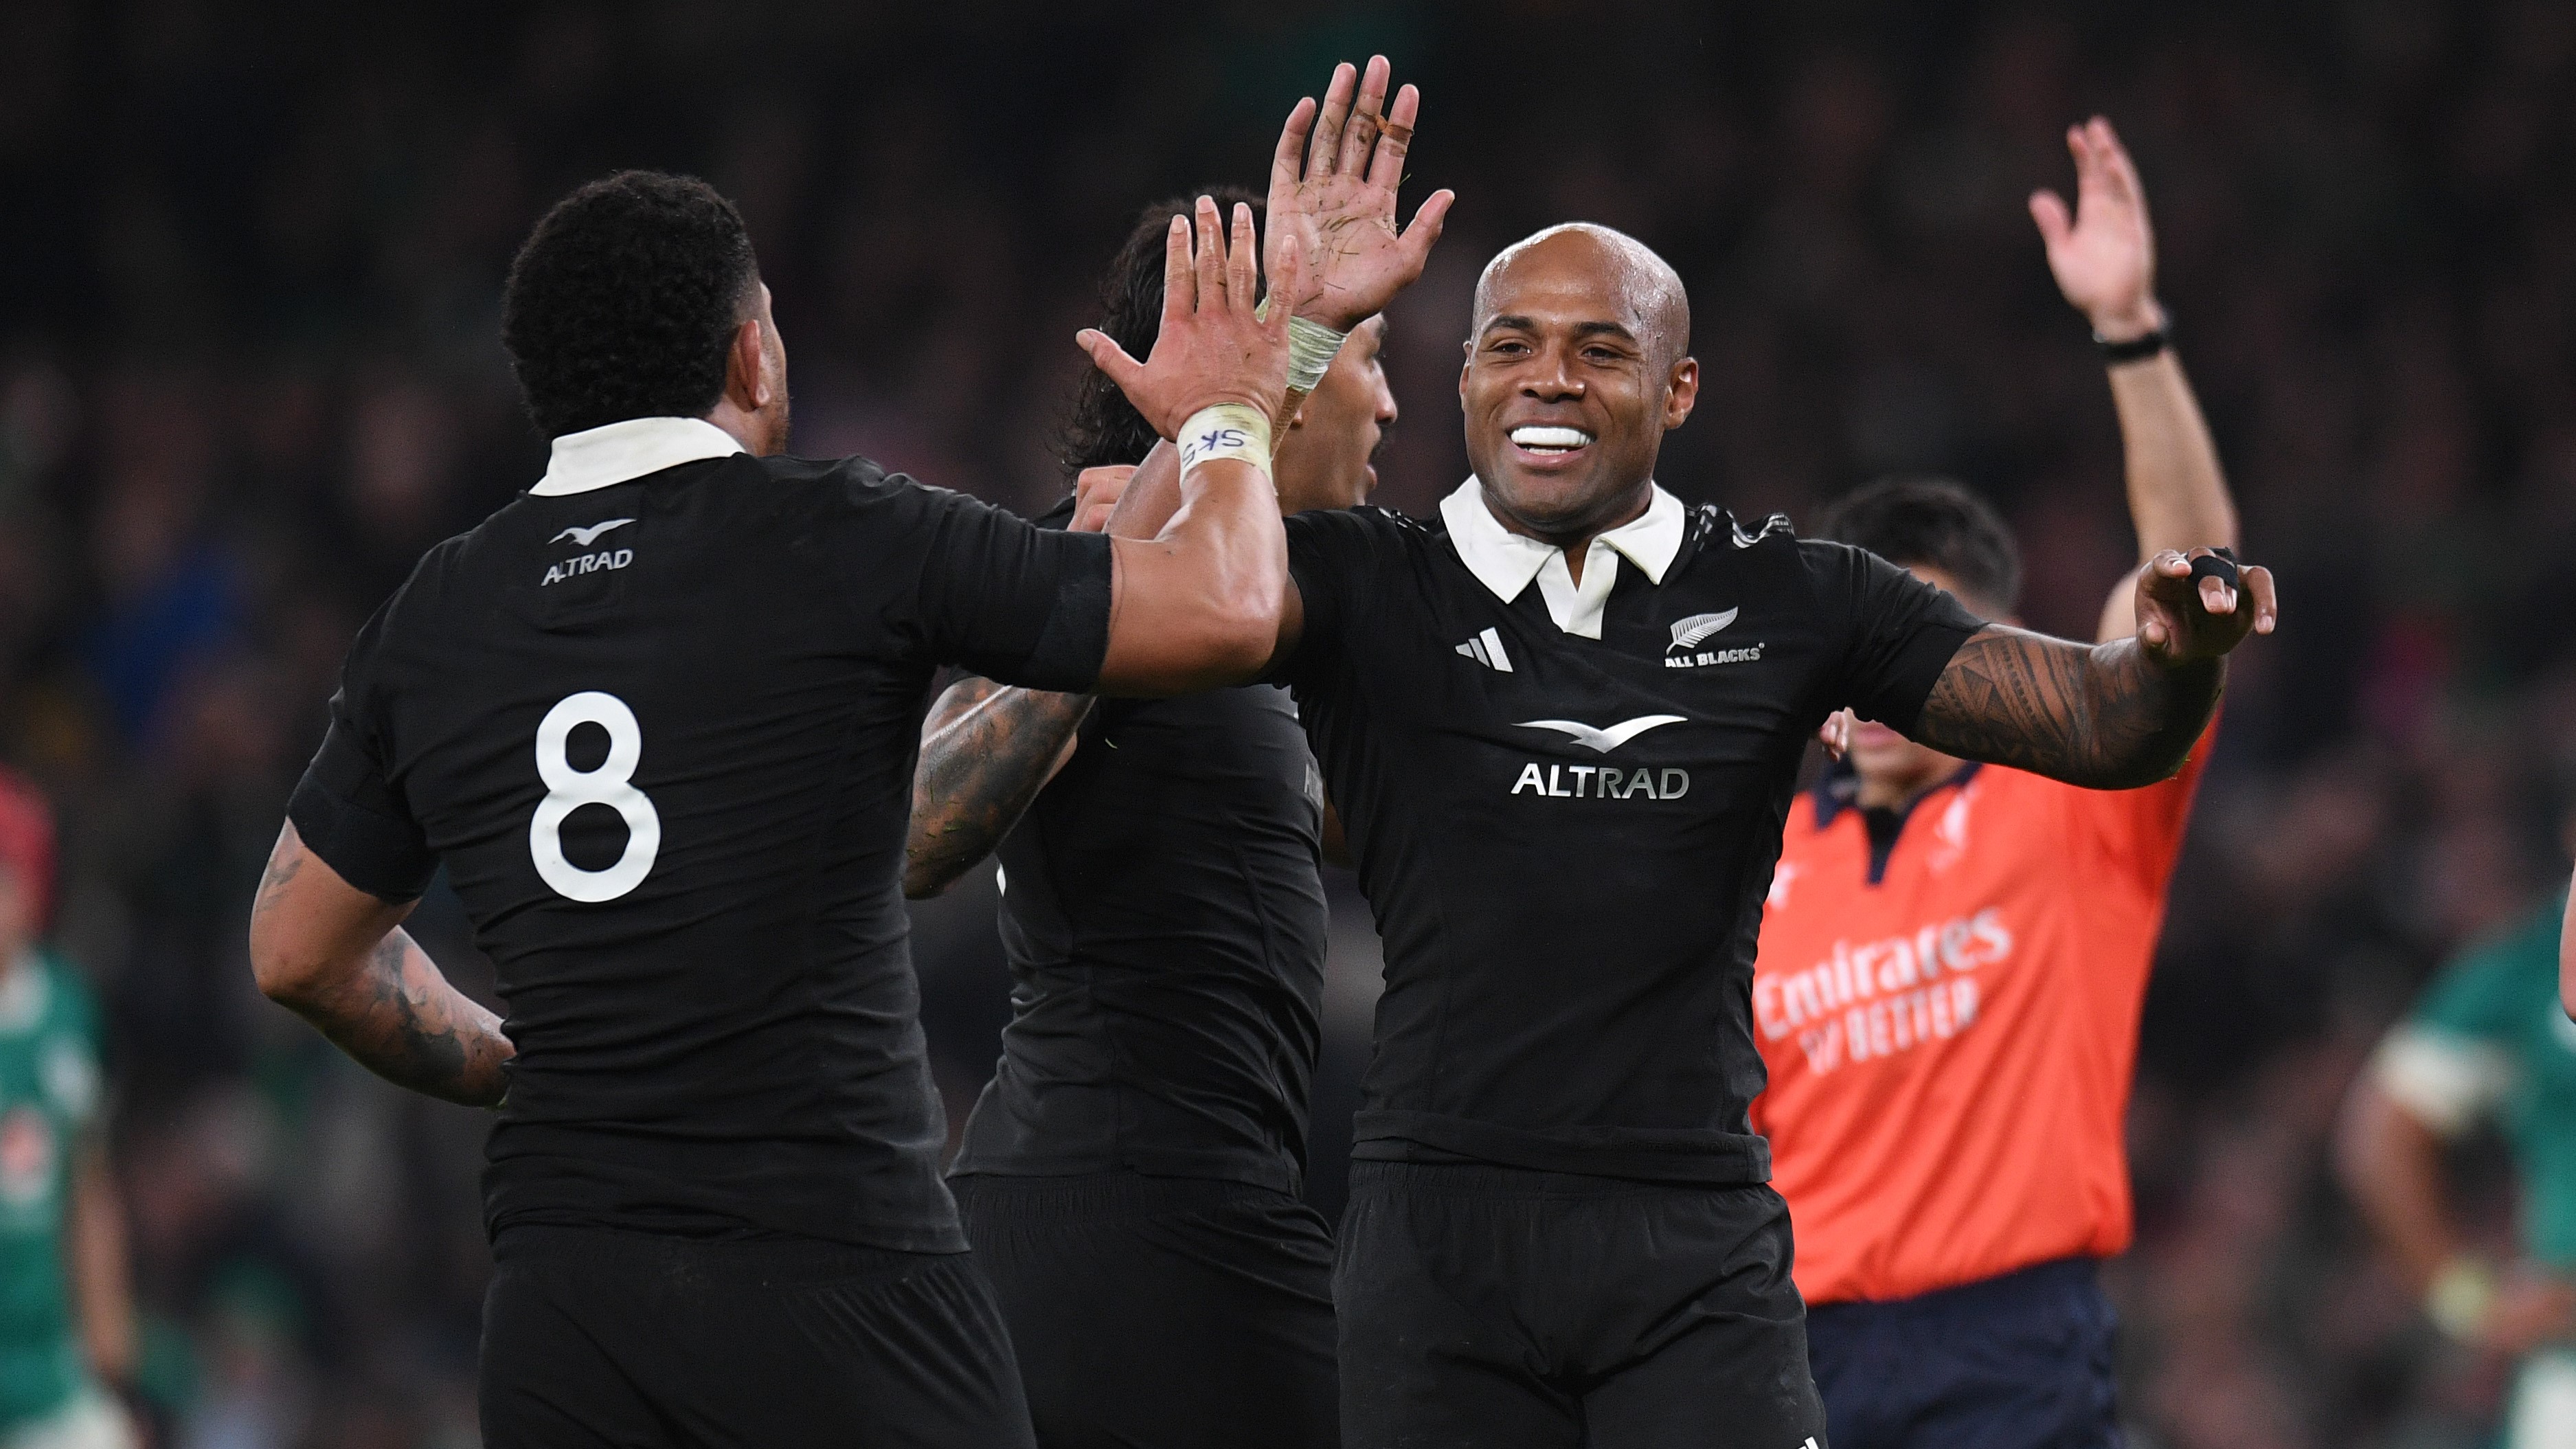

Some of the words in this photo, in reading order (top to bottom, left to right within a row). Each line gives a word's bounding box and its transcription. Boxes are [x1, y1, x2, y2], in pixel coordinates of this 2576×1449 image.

[541, 548, 633, 587] ALTRAD
[1664, 655, 1695, 668] ALL
[1696, 647, 1761, 666] BLACKS
[530, 690, 661, 903] 8
[1511, 763, 1690, 800] ALTRAD
[1753, 907, 2013, 1042] Emirates
